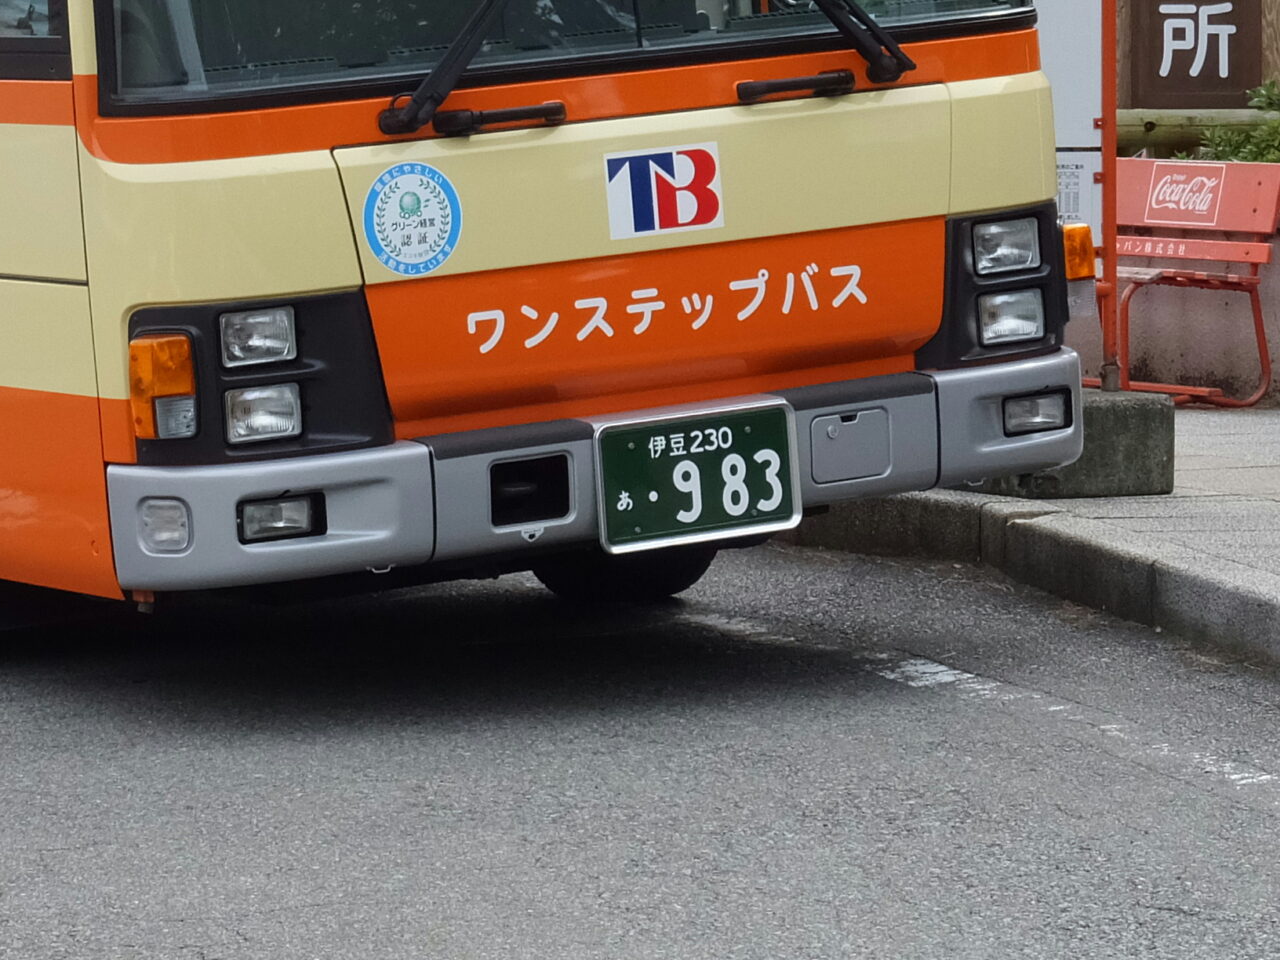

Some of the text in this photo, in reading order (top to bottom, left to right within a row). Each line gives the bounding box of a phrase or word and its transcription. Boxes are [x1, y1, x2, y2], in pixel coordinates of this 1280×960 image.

[467, 263, 868, 355] ワンステップバス
[616, 490, 634, 511] あ
